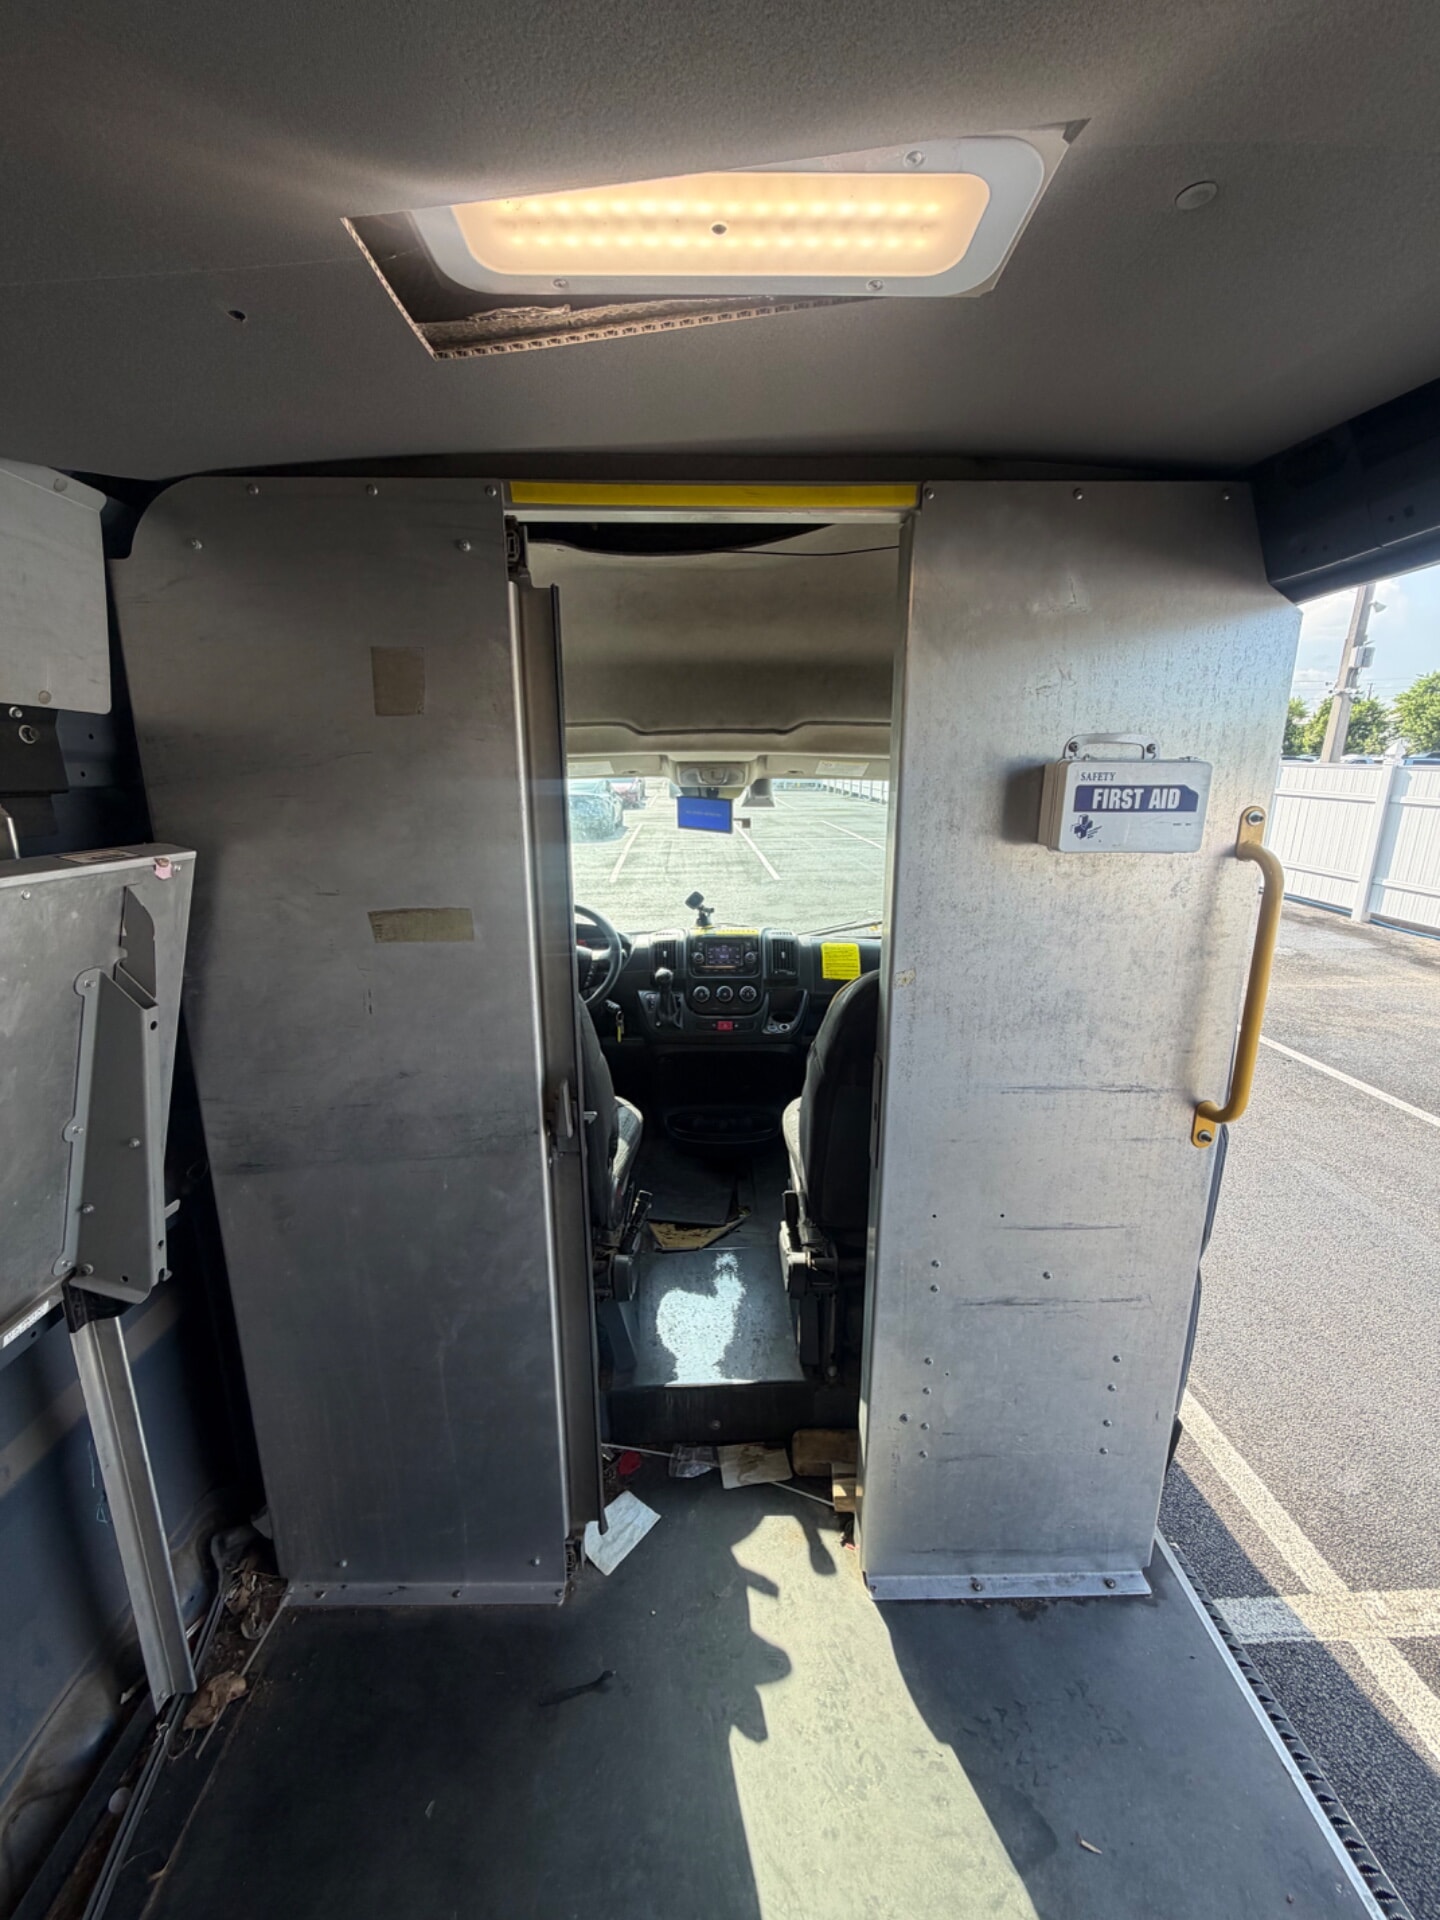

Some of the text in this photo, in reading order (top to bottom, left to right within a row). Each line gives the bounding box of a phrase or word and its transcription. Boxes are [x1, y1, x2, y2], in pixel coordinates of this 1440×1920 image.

[1080, 772, 1116, 781] SAFETY
[1092, 788, 1181, 809] FIRST AID
